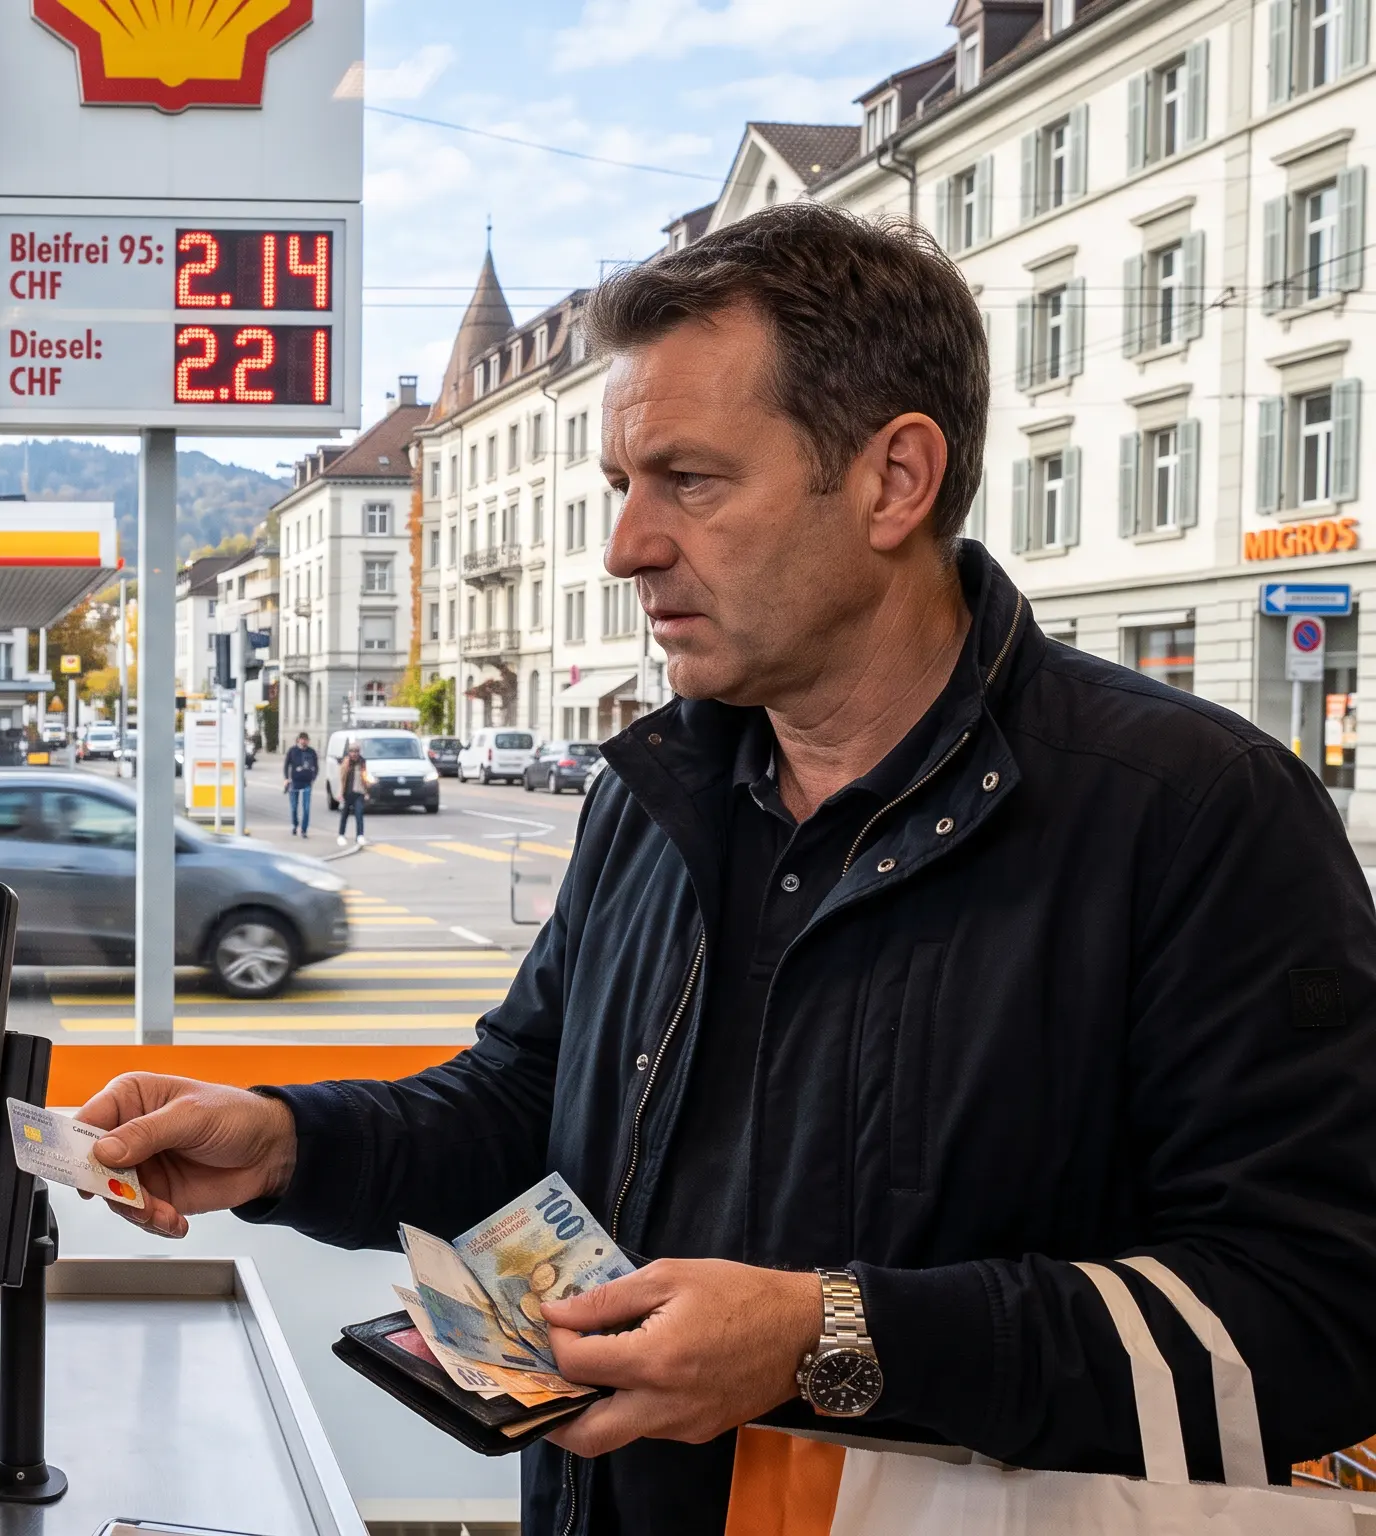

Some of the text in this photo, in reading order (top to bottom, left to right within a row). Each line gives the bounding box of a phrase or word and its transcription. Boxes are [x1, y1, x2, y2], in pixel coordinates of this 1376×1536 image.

[10, 231, 164, 265] Bleifrei 95:
[9, 270, 62, 300] CHF
[176, 231, 329, 308] 2.14
[10, 328, 103, 359] Diesel:
[9, 366, 62, 396] CHF
[175, 326, 327, 402] 2.21
[1244, 518, 1359, 561] MIGROS
[535, 1187, 585, 1241] 100
